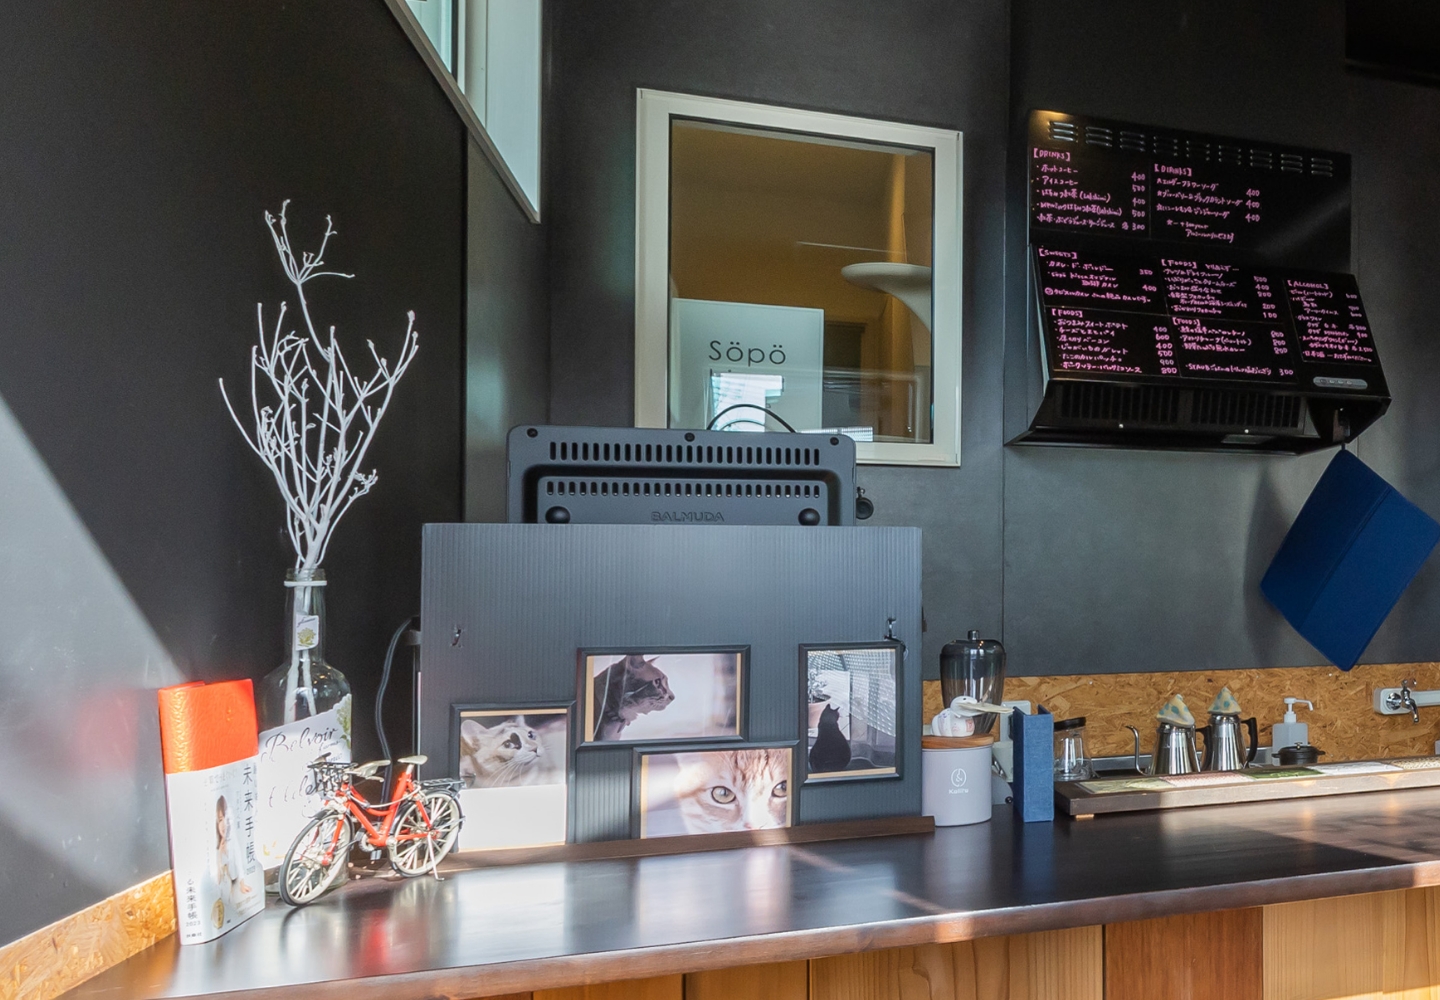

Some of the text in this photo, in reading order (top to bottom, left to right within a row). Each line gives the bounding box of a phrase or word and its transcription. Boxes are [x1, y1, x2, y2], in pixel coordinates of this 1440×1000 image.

[1131, 171, 1146, 182] 400
[1245, 188, 1260, 198] 400
[1131, 197, 1146, 207] 400
[1245, 199, 1260, 210] 400
[1131, 209, 1146, 218] 500
[1245, 213, 1260, 223] 400
[1132, 222, 1146, 231] 300
[1142, 284, 1157, 292] 400
[1155, 342, 1173, 350] 400
[709, 340, 786, 367] Söpö
[1279, 368, 1294, 376] 300
[650, 511, 726, 522] BALMUDA
[265, 727, 339, 761] Belvoir
[242, 763, 256, 865] 未来手帳
